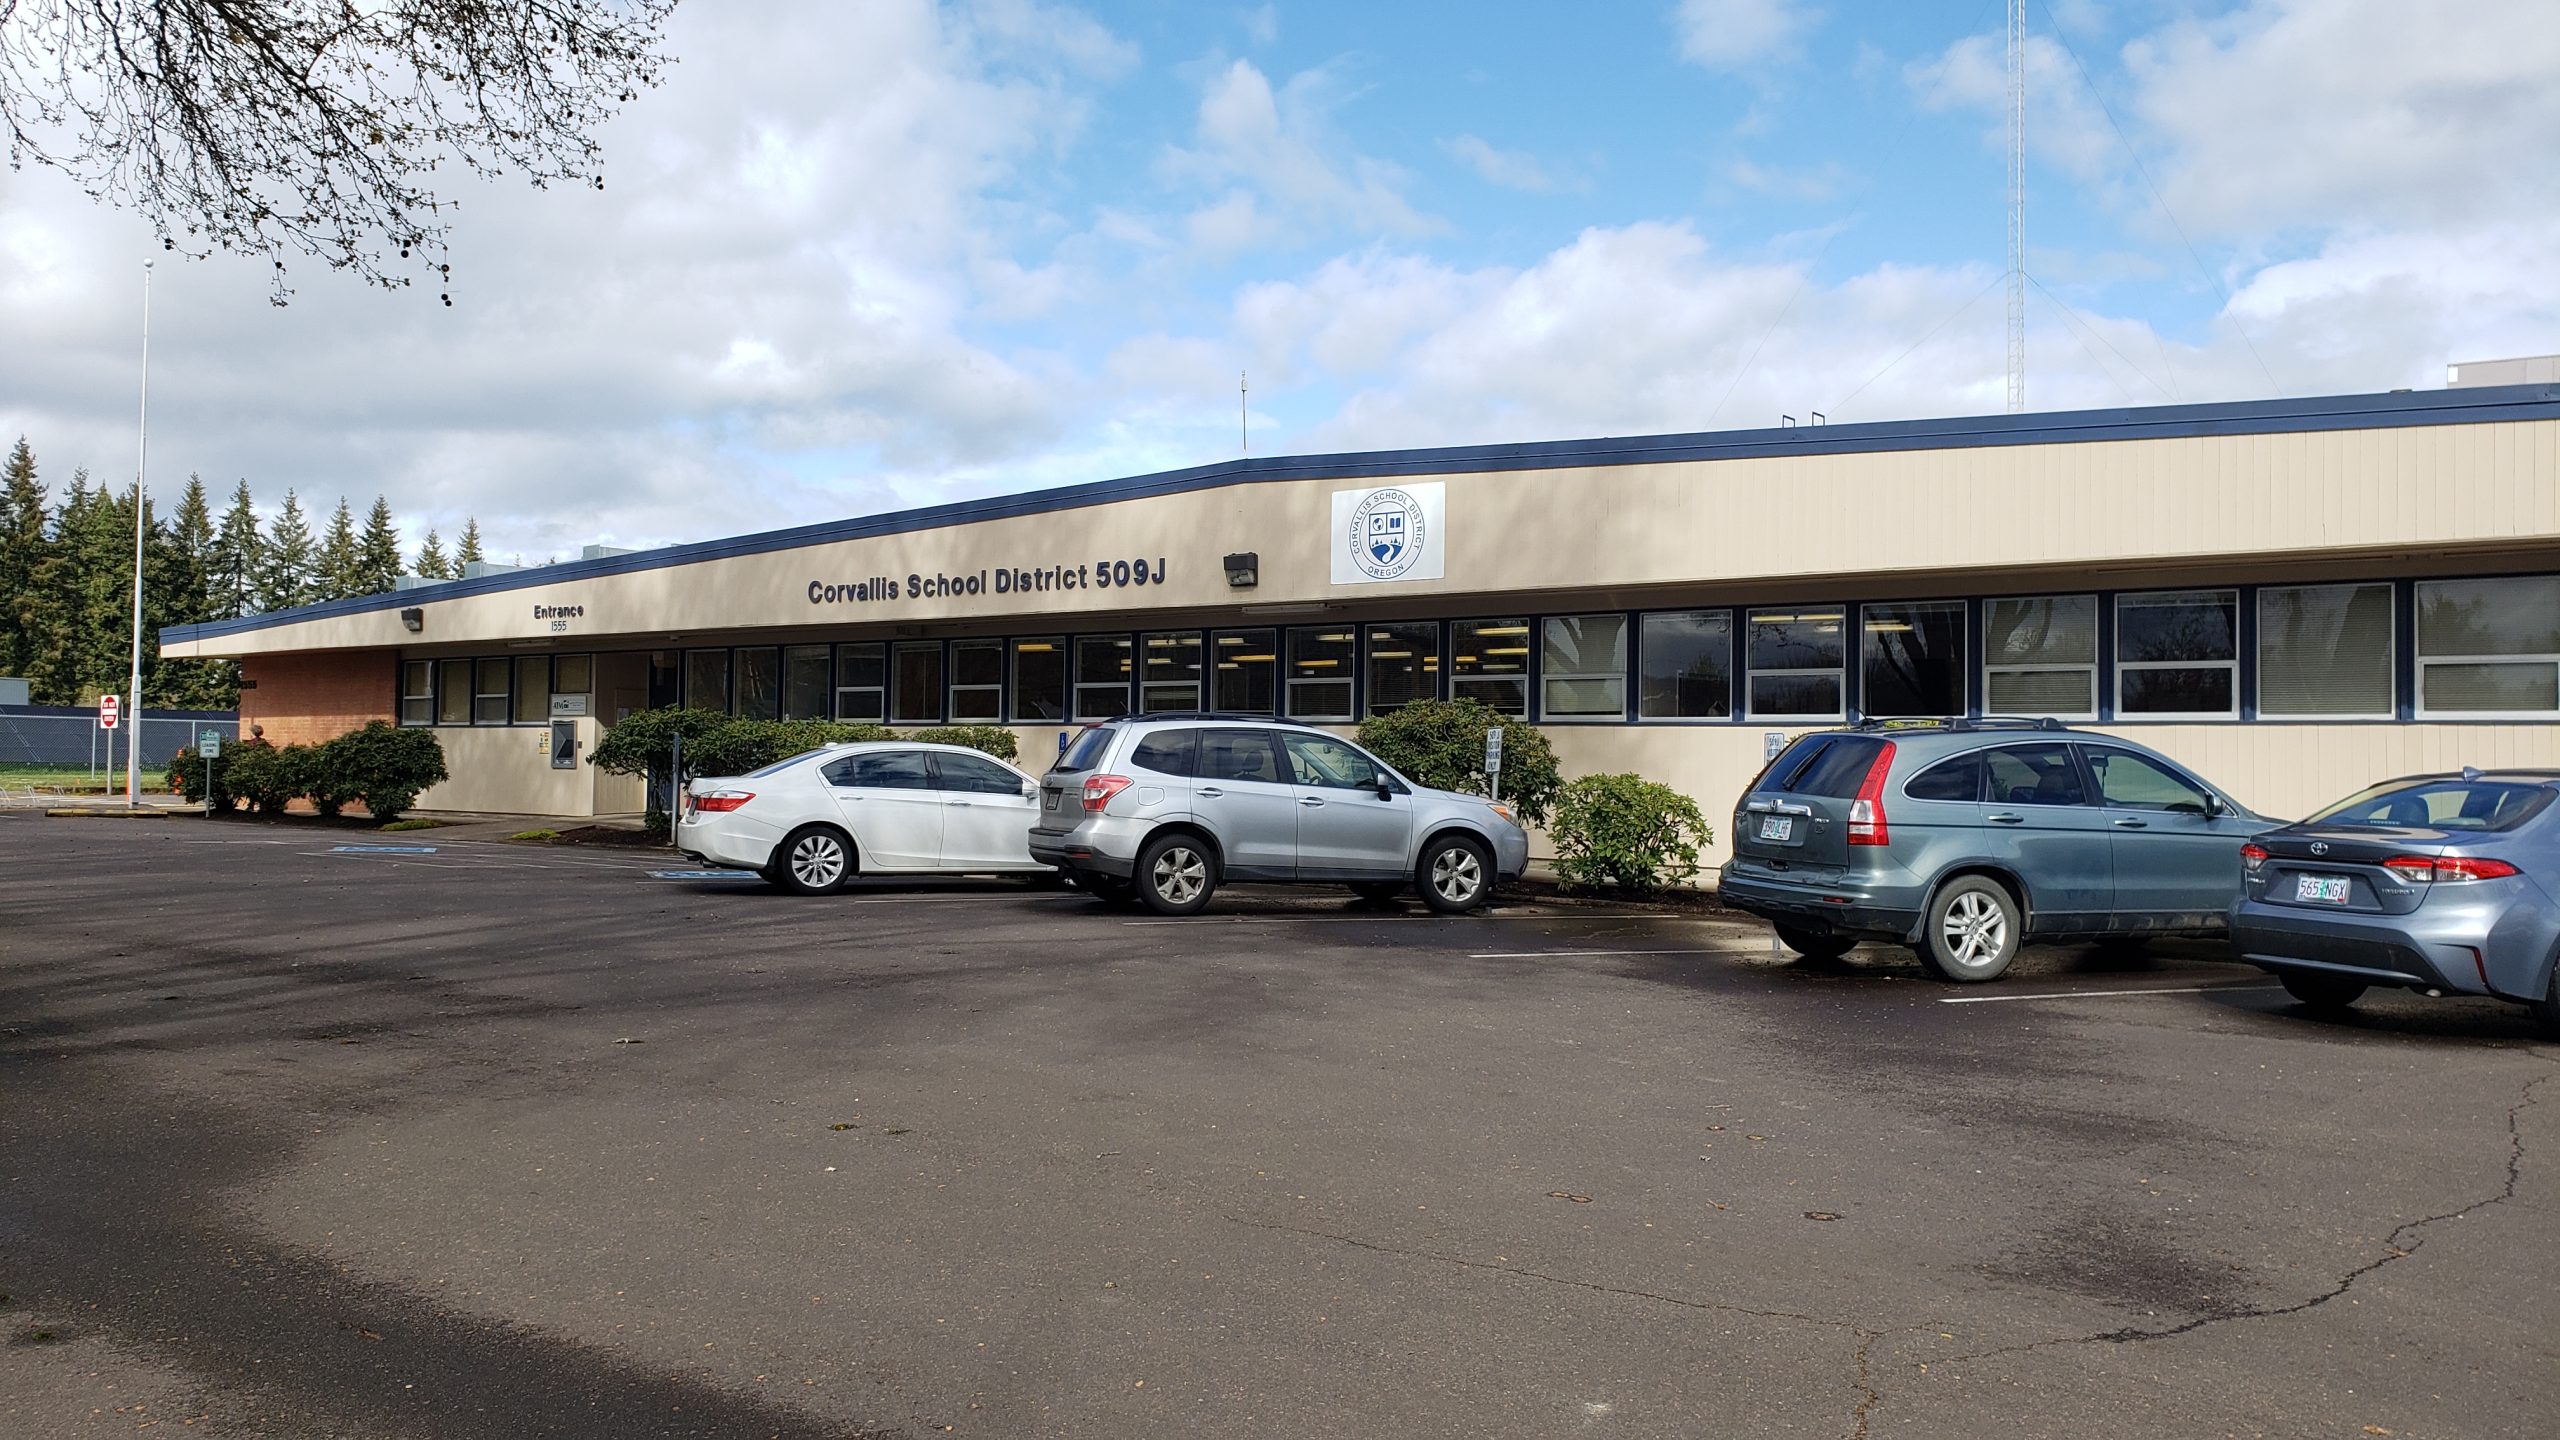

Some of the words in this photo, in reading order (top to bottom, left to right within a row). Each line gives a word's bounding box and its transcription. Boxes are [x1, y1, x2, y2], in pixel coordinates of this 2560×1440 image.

[1351, 501, 1372, 554] CORVALLIS
[1373, 492, 1407, 504] SCHOOL
[1409, 503, 1423, 551] DISTRICT
[1367, 563, 1404, 577] OREGON
[808, 577, 899, 604] Corvallis
[907, 570, 987, 598] School
[995, 565, 1088, 594] District
[1096, 558, 1166, 588] 509J
[534, 605, 584, 619] Entrance
[551, 620, 567, 631] 1555
[1764, 820, 1776, 834] 390
[2300, 880, 2319, 896] 565
[2325, 882, 2346, 898] NGX
